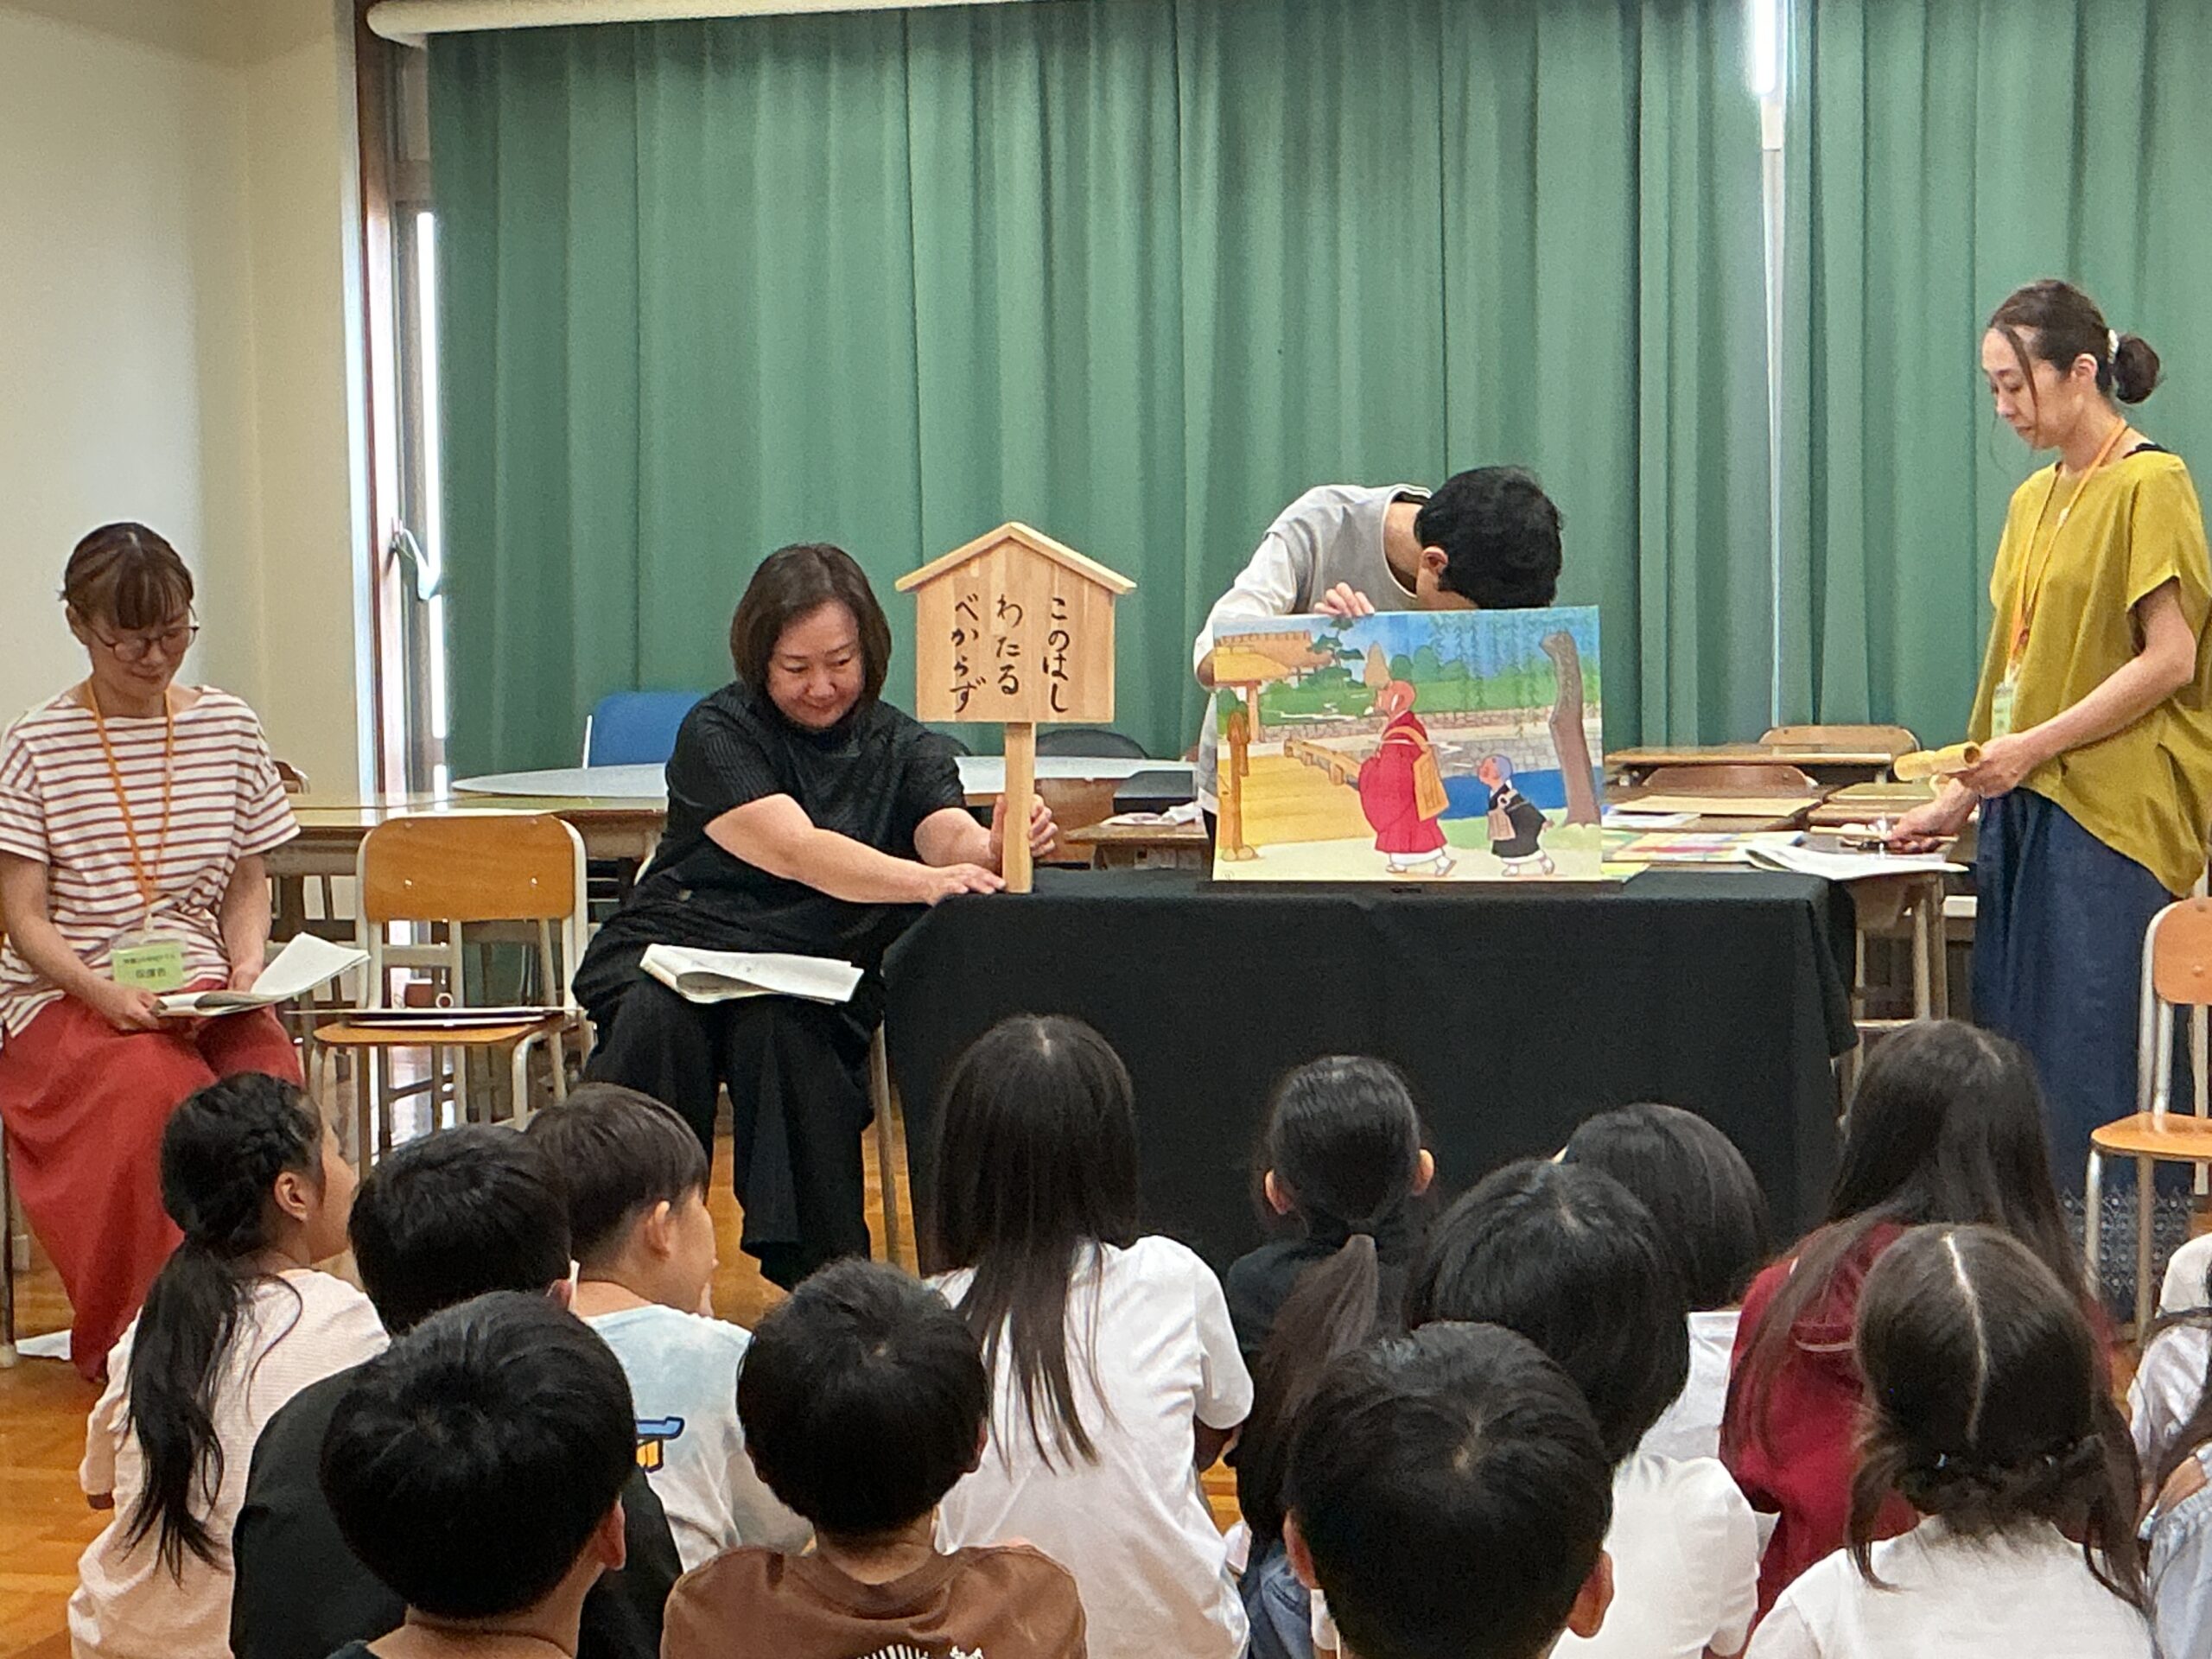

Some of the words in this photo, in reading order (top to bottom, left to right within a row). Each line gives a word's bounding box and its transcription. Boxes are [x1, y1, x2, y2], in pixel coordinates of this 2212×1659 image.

[950, 593, 987, 714] べからず
[995, 594, 1023, 696] わたる
[1042, 597, 1071, 713] このはし
